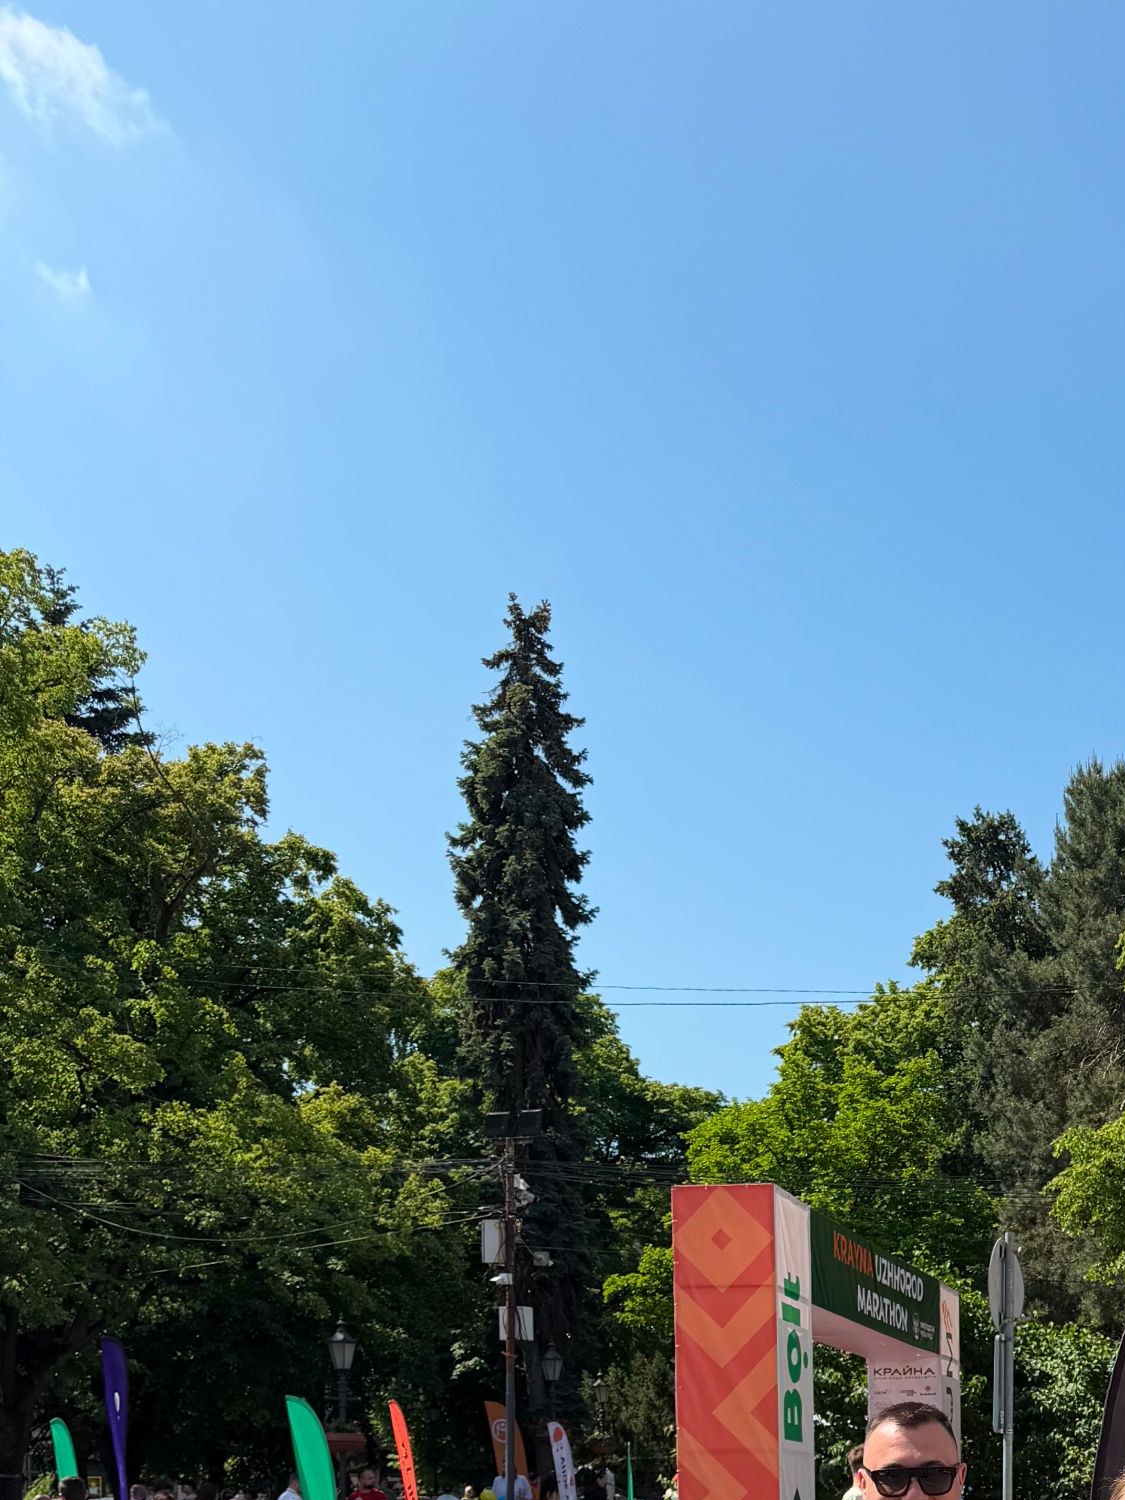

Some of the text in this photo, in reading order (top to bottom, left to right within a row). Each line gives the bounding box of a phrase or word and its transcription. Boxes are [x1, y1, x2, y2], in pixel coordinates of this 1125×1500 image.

[833, 1231, 924, 1302] KRAYNA UZHHOROD
[857, 1284, 908, 1333] MARATHON
[782, 1272, 808, 1442] Bolt
[873, 1364, 935, 1377] КРАЙНА
